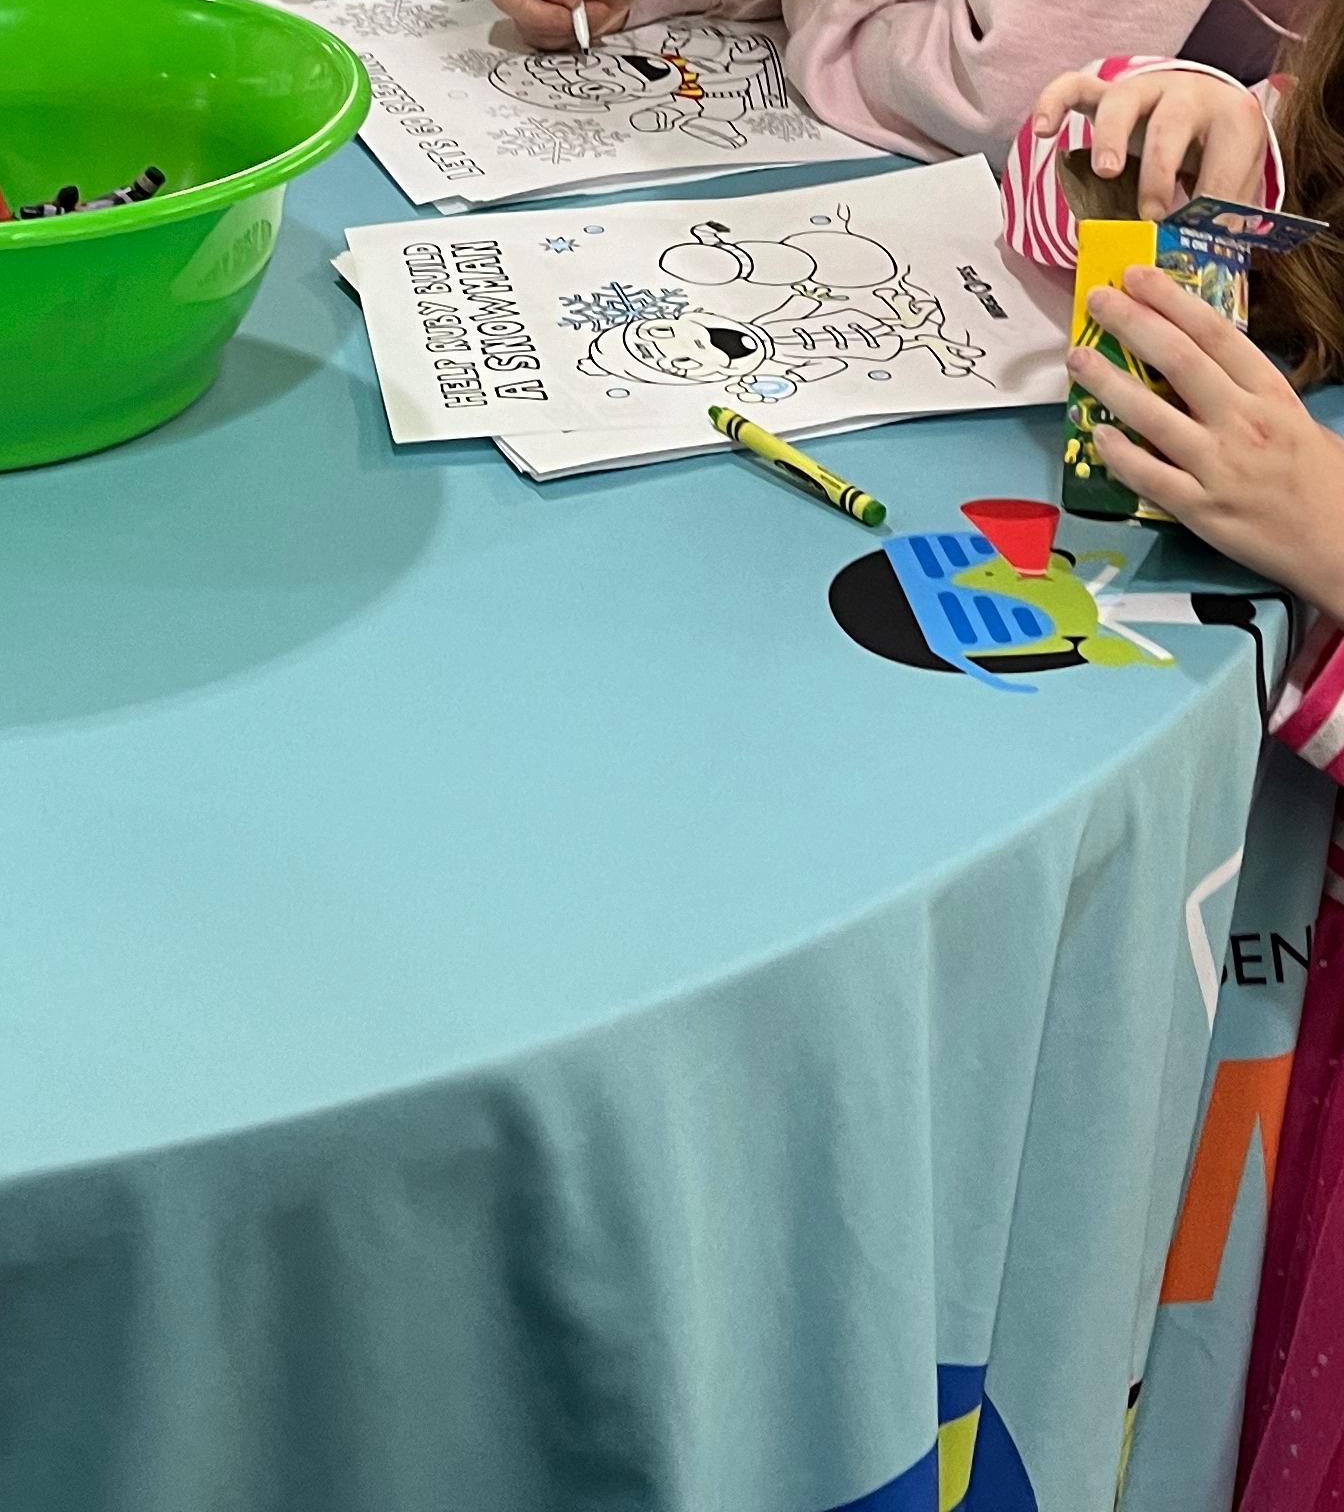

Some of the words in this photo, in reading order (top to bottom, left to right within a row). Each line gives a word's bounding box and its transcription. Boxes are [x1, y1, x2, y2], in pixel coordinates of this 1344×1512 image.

[403, 242, 452, 294] BUILD
[417, 301, 472, 352] RUBY
[451, 241, 540, 371] SNOWMAN
[434, 359, 488, 408] HELP
[494, 379, 548, 400] A
[1220, 924, 1312, 986] EN
